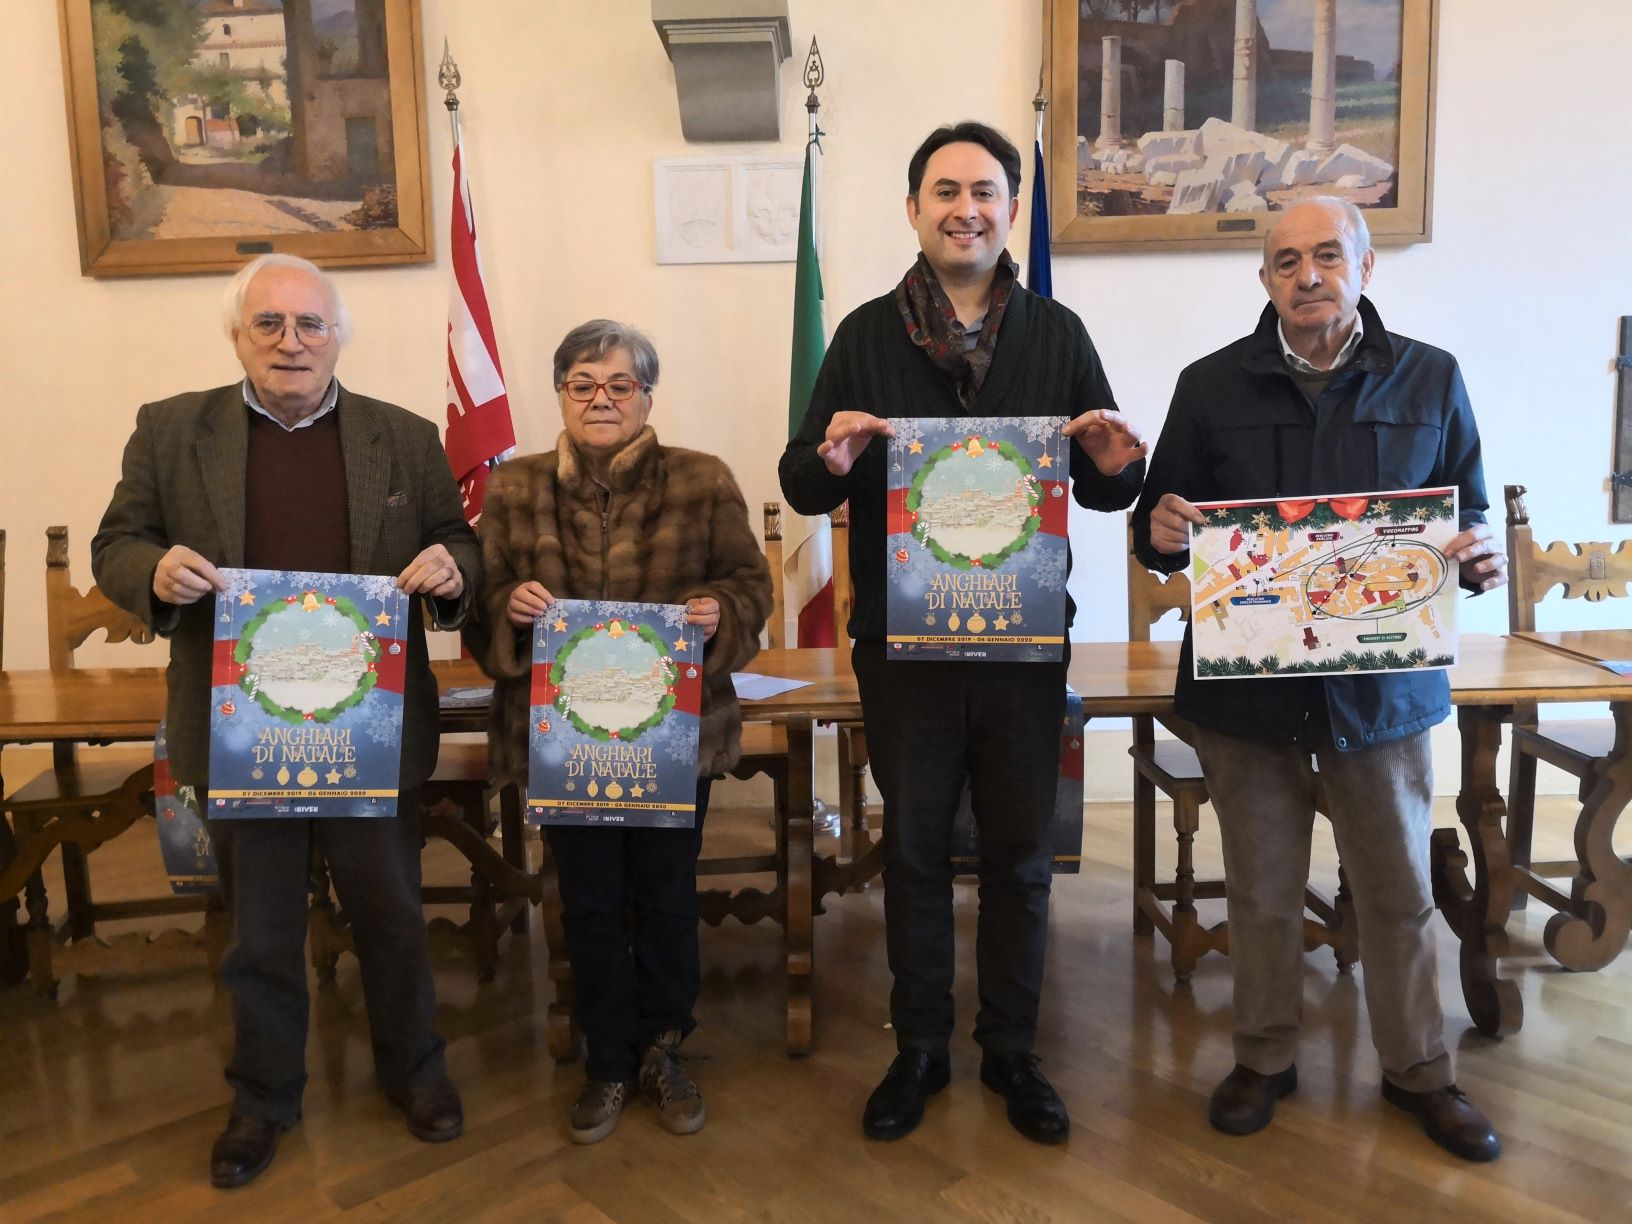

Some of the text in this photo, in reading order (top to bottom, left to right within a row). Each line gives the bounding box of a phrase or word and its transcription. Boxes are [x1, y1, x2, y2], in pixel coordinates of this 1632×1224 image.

[1382, 526, 1419, 534] VIDEOMAPPING
[930, 574, 1017, 592] ANGHIARI
[925, 591, 1023, 609] DI NATALE
[259, 727, 350, 746] ANGHIARI
[252, 745, 356, 764] DI NATALE
[571, 744, 653, 762] ANGHIARI
[565, 761, 657, 778] DI NATALE
